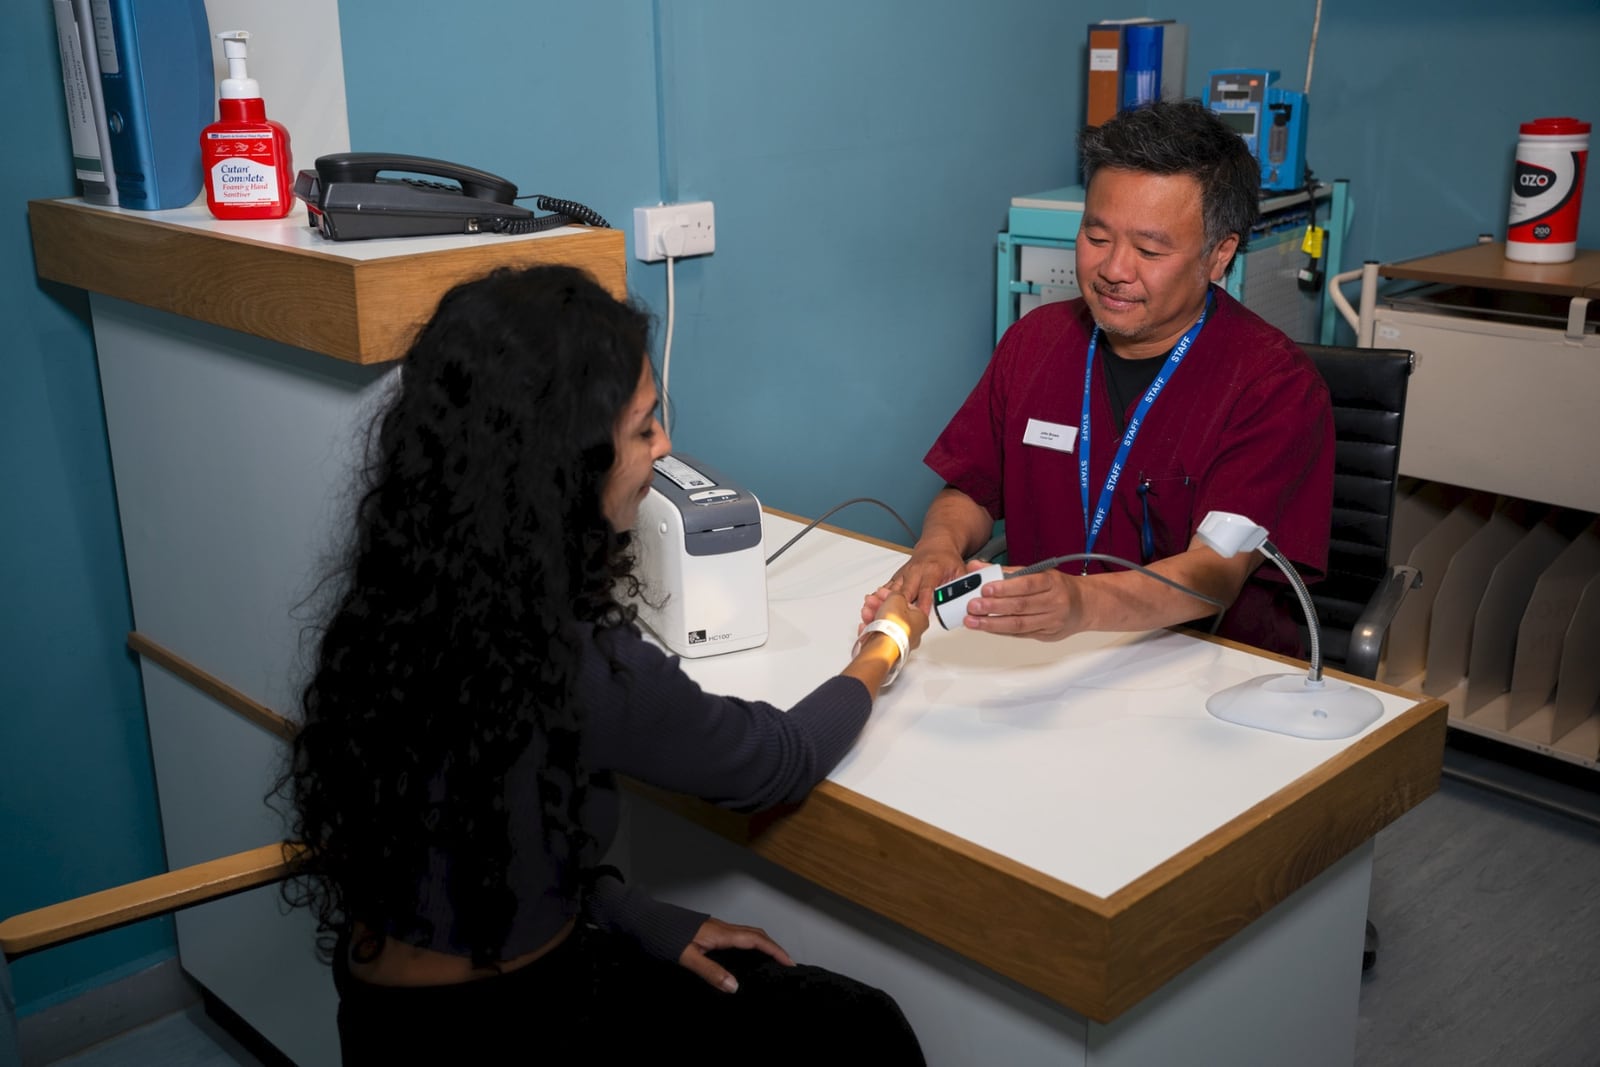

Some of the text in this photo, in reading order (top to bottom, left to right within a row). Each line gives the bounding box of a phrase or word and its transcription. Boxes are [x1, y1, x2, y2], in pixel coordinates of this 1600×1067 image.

[221, 164, 248, 174] Cutan
[1520, 174, 1548, 187] azo
[1534, 226, 1550, 234] 200
[1171, 335, 1191, 363] STAFF
[1145, 376, 1164, 403] STAFF
[1124, 418, 1140, 446] STAFF
[1080, 460, 1088, 488] STAFF
[1106, 462, 1122, 491] STAFF
[1091, 507, 1105, 535] STAFF
